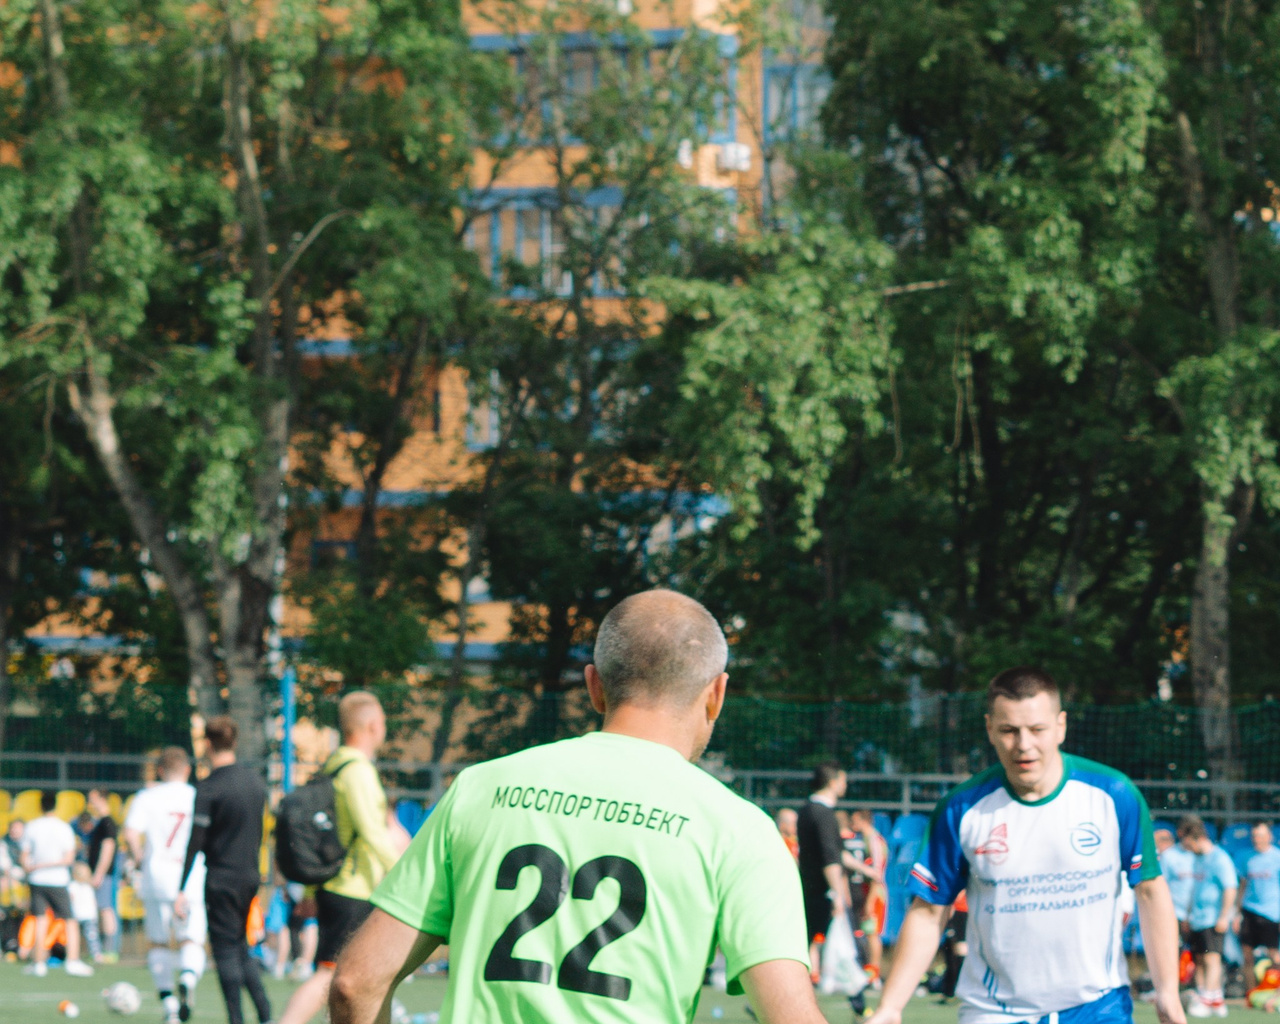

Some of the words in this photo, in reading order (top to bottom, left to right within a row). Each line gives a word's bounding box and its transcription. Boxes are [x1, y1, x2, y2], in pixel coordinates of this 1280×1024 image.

[166, 810, 186, 848] 7
[491, 786, 690, 837] МОССПОРТОБЪЕКТ
[1008, 882, 1087, 898] ОРГАНИЗАЦИЯ
[484, 843, 647, 1001] 22
